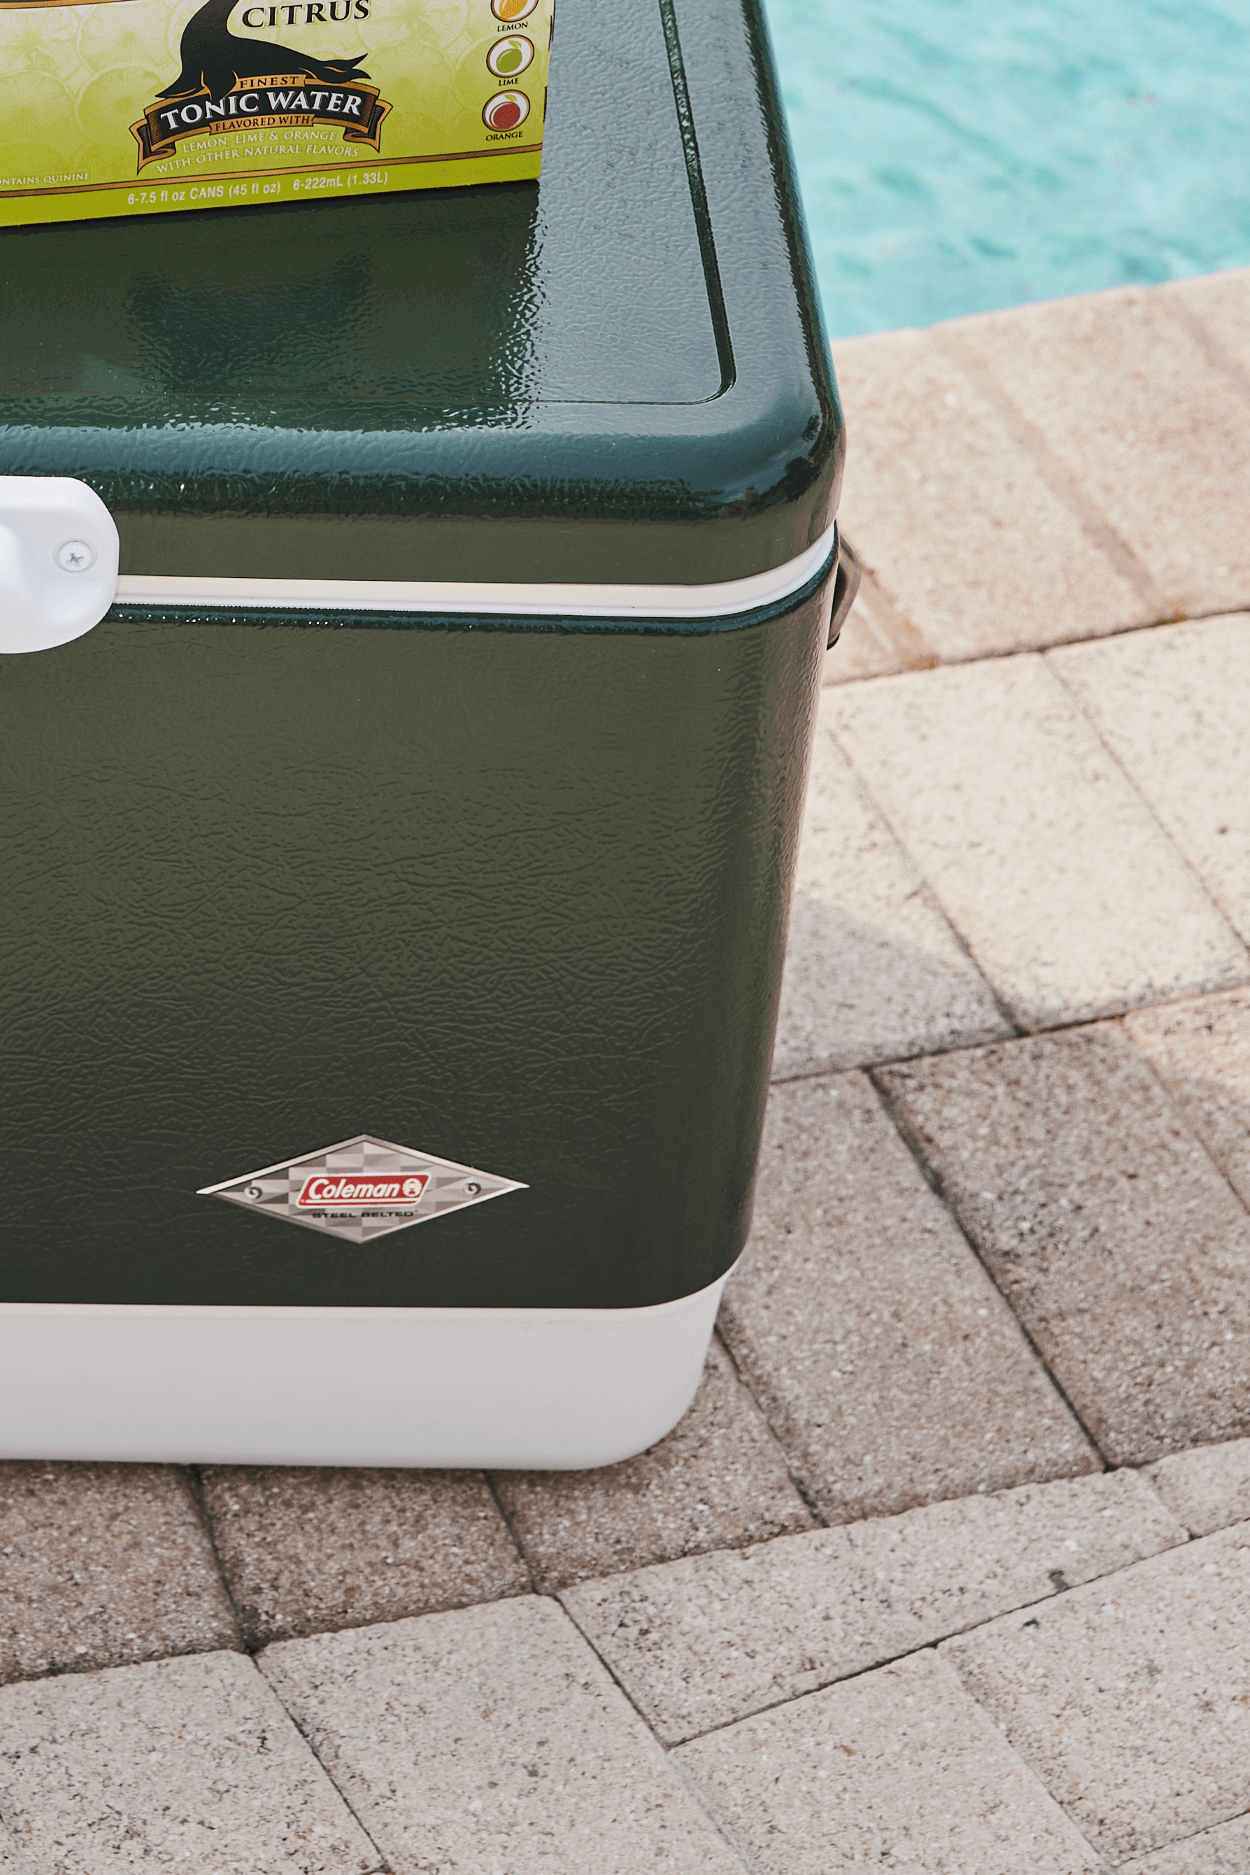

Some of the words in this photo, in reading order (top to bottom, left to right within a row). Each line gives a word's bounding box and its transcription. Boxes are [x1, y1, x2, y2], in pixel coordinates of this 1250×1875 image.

[242, 0, 371, 28] CITRUS
[497, 22, 528, 32] LEMON
[239, 77, 299, 88] FINEST
[498, 78, 519, 86] LIME
[160, 91, 260, 130] TONIC
[266, 91, 363, 116] WATER
[215, 118, 275, 131] FLAVORED
[278, 116, 311, 125] WITH
[486, 131, 523, 141] ORANGE
[128, 191, 156, 205] 6-7.5
[160, 189, 168, 201] fl
[172, 191, 185, 201] oz
[190, 185, 224, 200] CANS
[229, 184, 247, 198] (45
[252, 183, 259, 195] fl
[263, 182, 281, 194] oz)
[293, 177, 342, 191] 6-222mL
[347, 172, 388, 188] (1.33L)
[308, 1179, 399, 1199] Coleman
